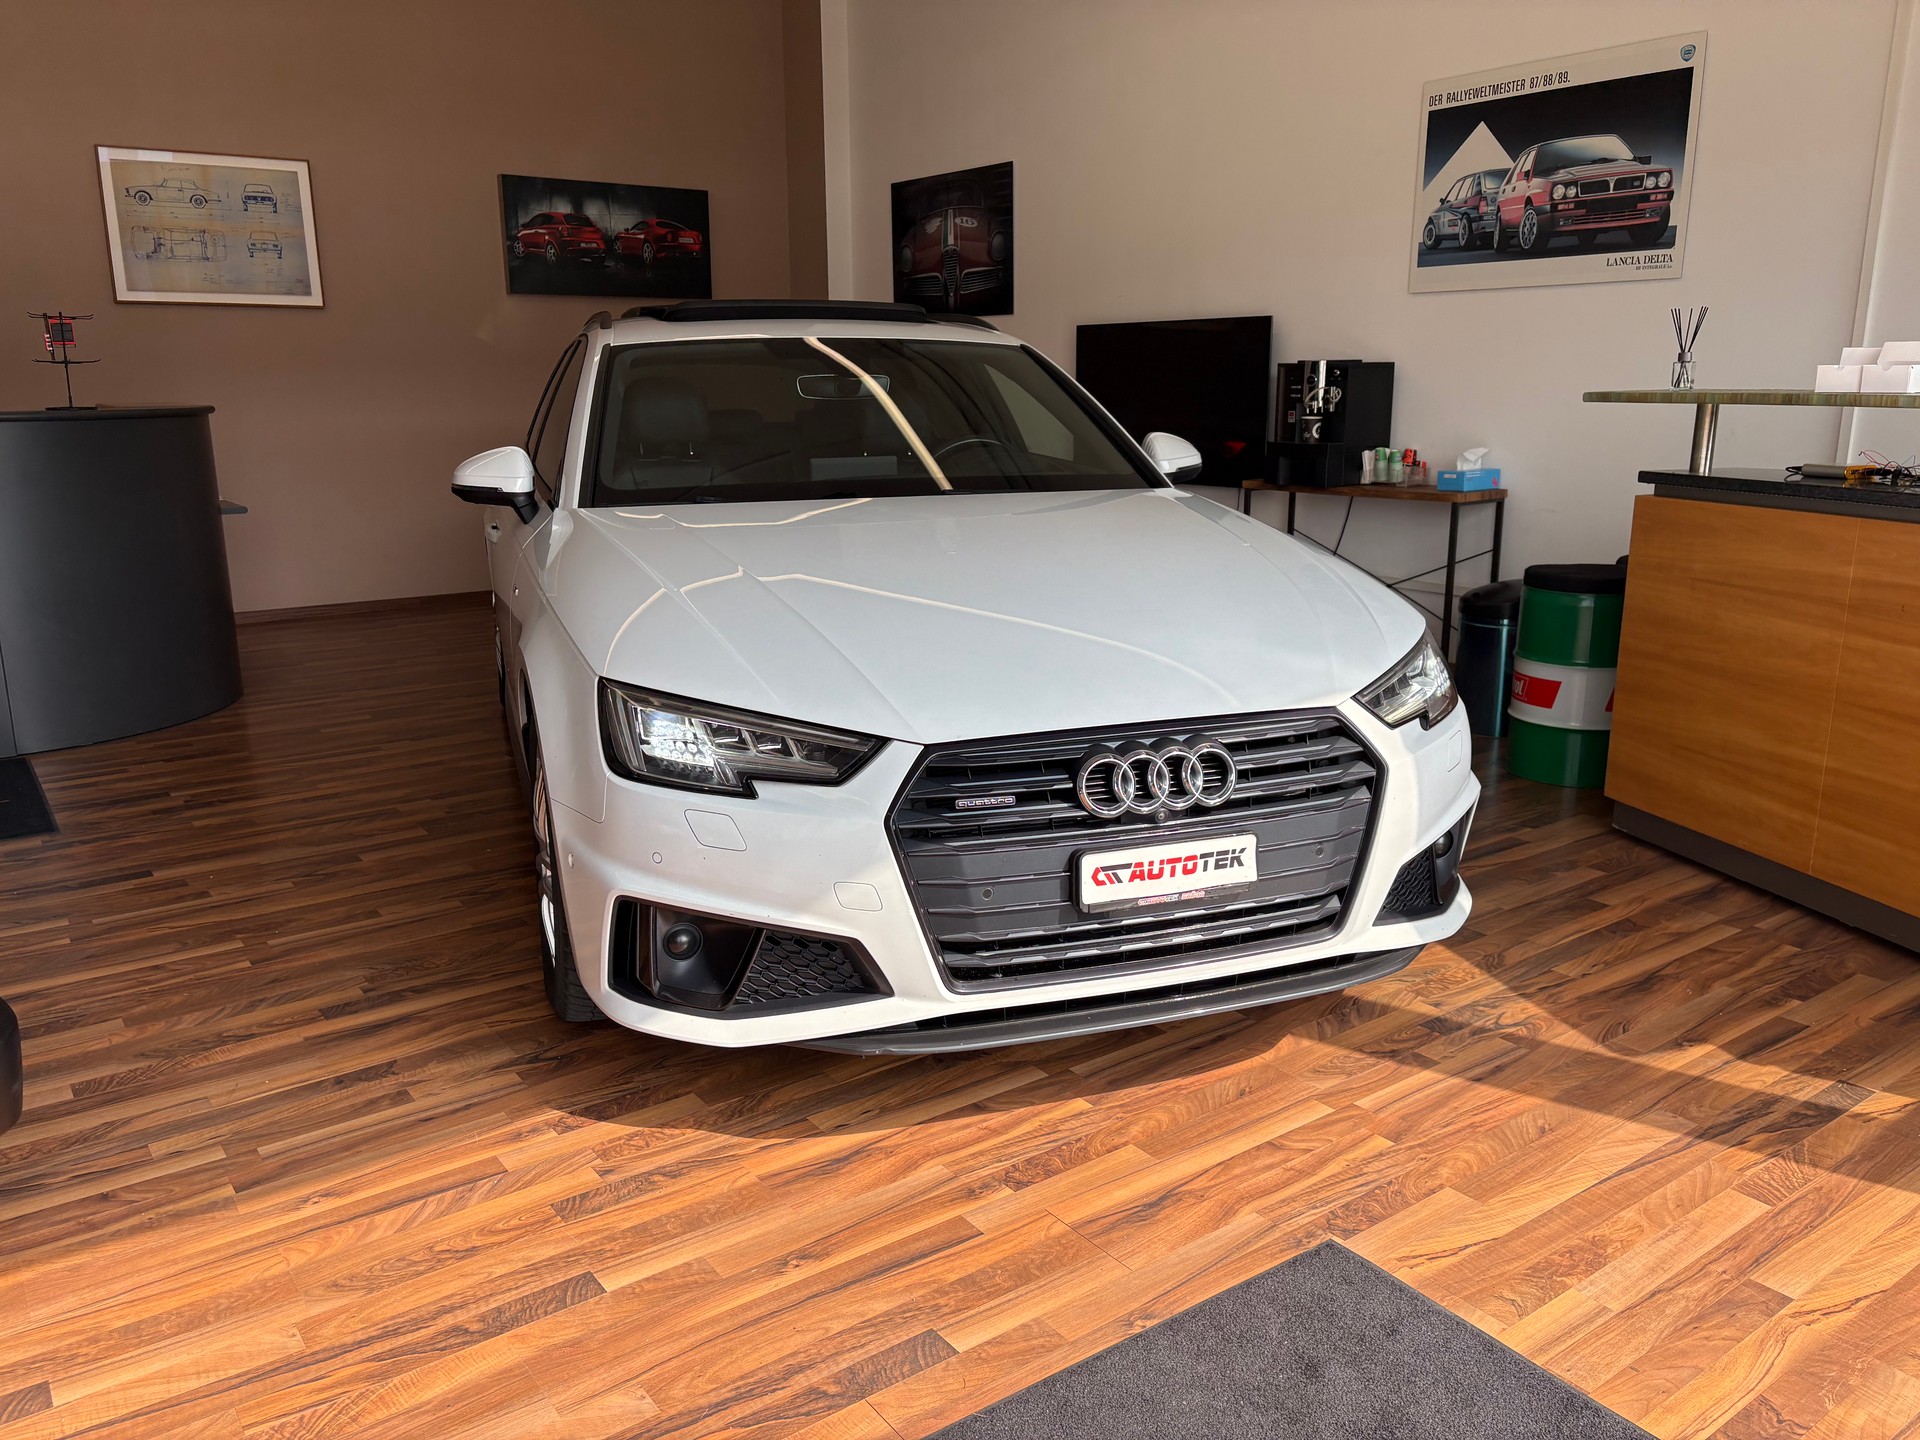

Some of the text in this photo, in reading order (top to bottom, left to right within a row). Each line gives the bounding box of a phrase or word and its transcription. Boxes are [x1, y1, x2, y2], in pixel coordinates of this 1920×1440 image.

[1429, 70, 1571, 108] DER RALLYEWELTMEISTER 87/88/89.
[1606, 253, 1674, 267] LANCIA DELTA
[958, 797, 1013, 809] quattro
[1128, 847, 1248, 883] AUTOTEK
